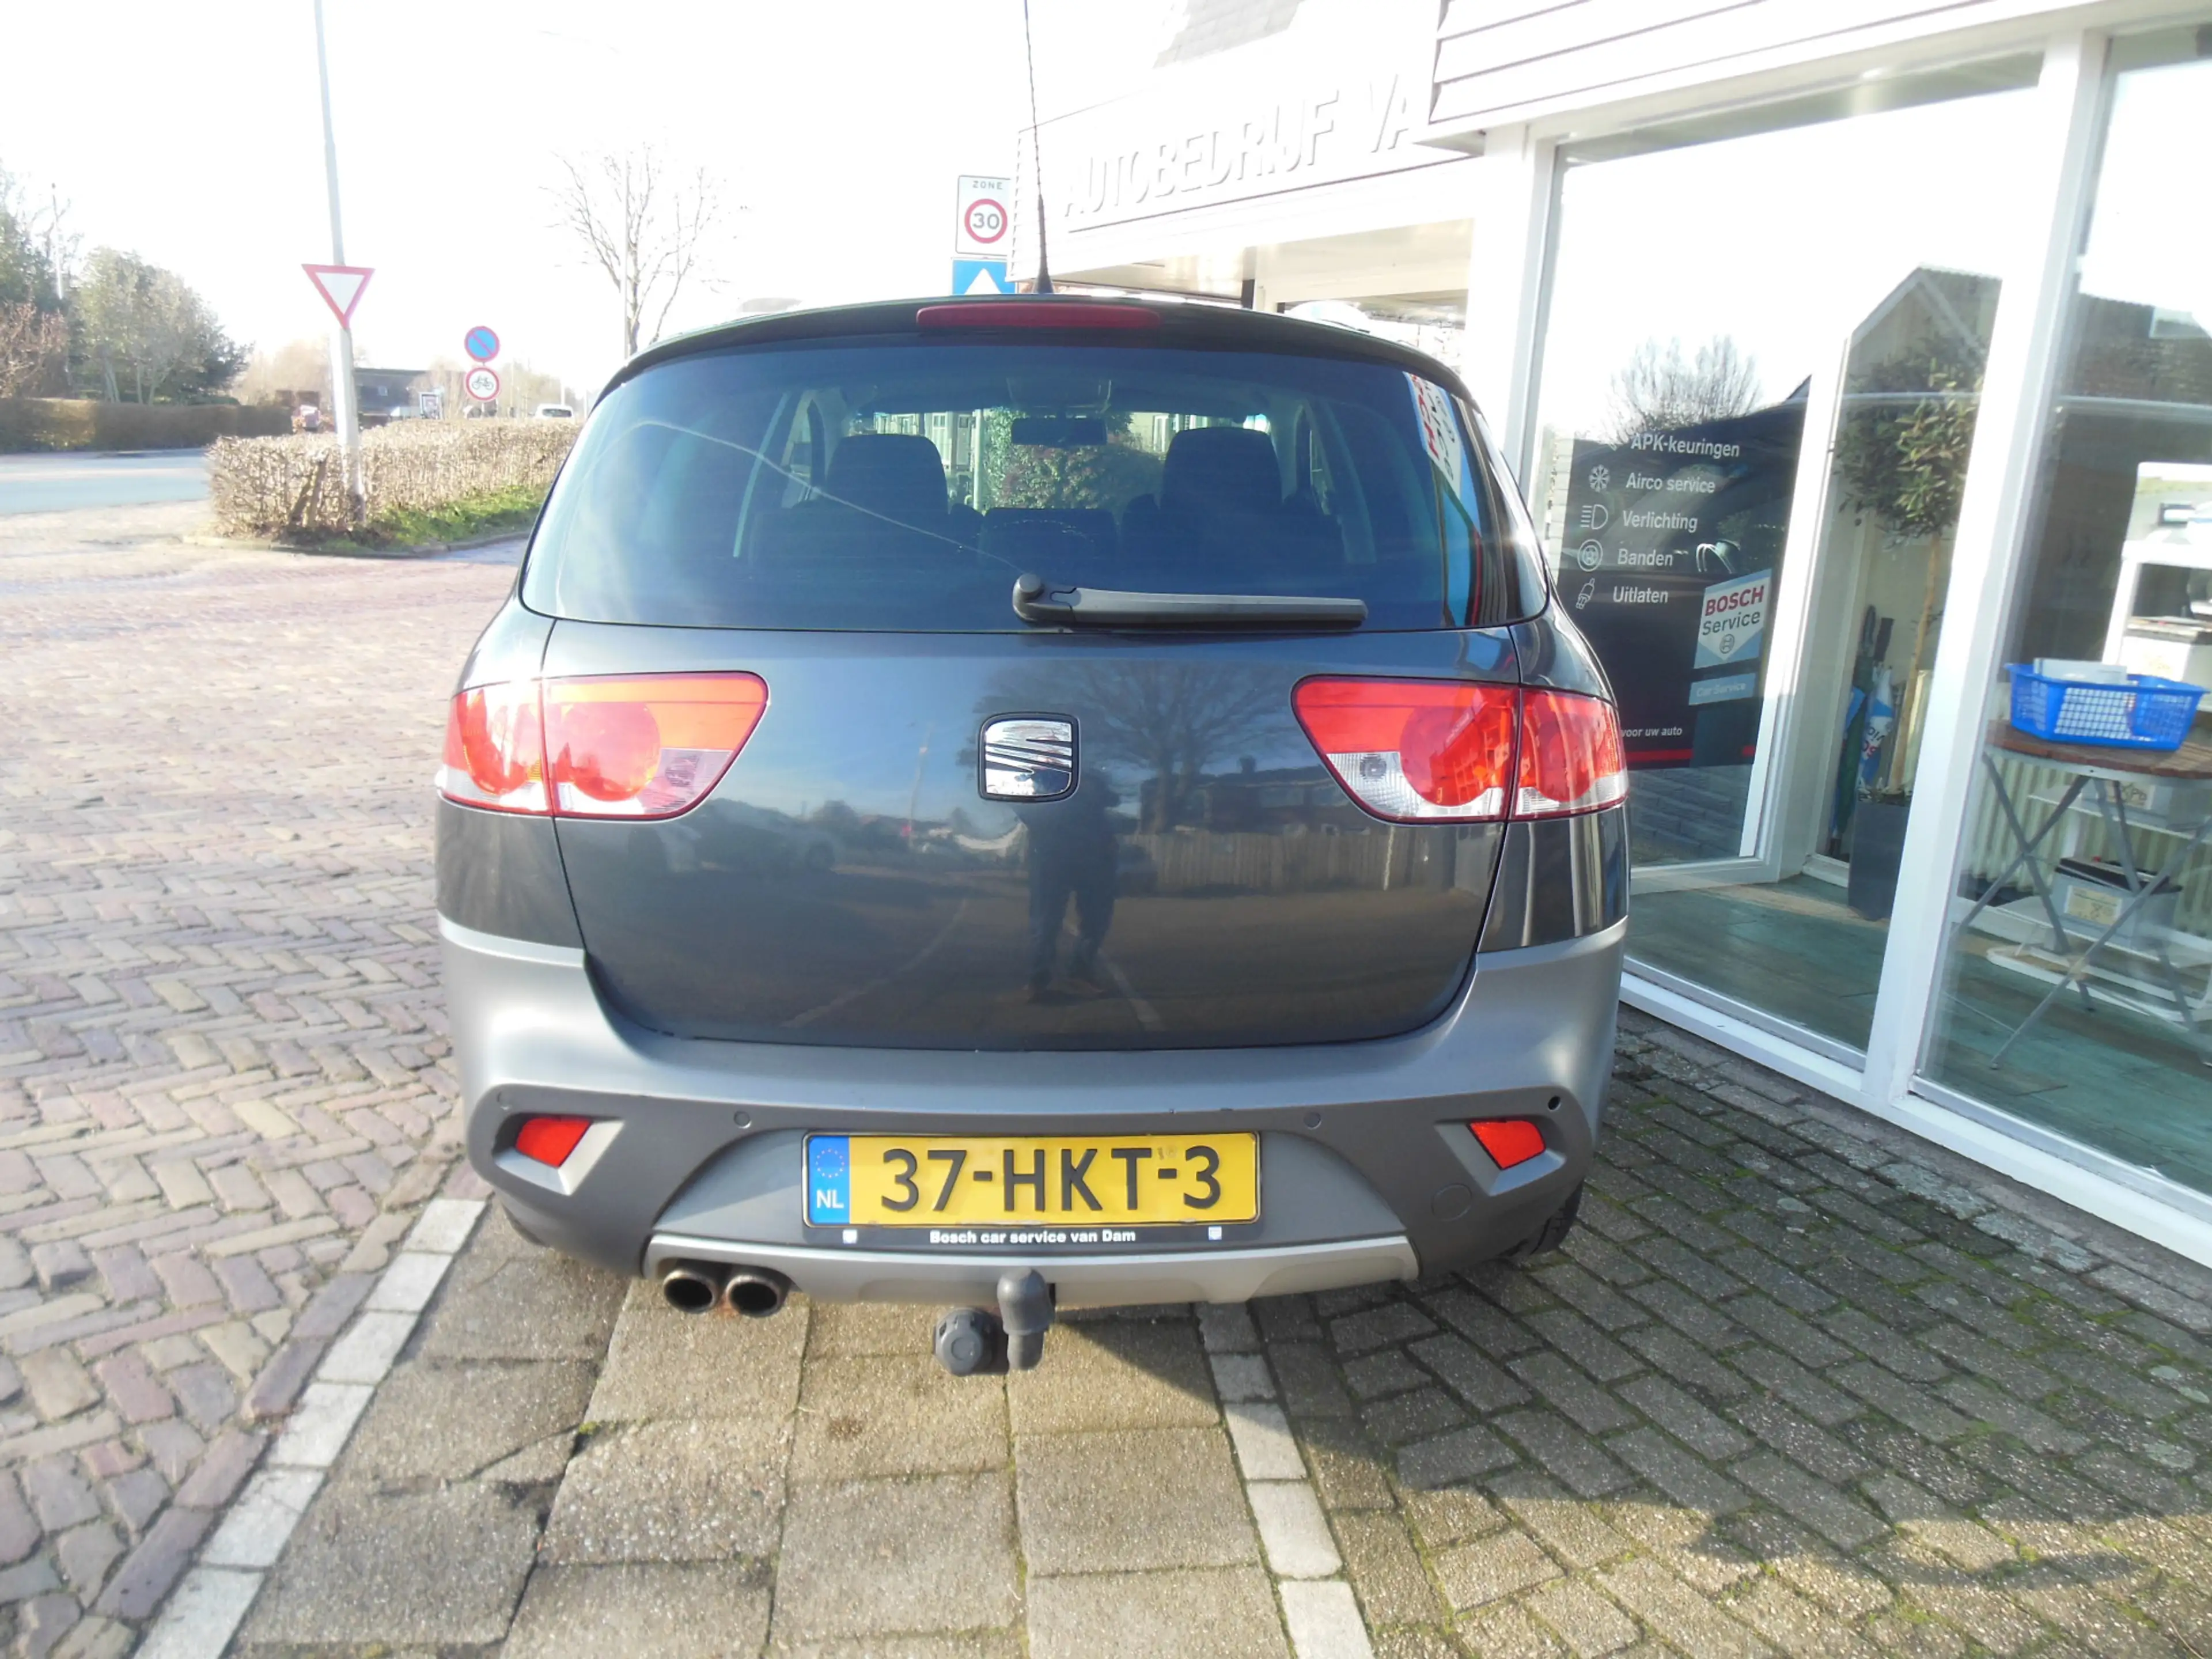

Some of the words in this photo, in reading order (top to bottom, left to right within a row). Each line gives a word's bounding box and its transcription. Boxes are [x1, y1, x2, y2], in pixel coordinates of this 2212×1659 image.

[1062, 89, 1340, 218] AUTOBEDRIJF
[972, 180, 1003, 190] ZONE
[972, 213, 1000, 230] 30
[1630, 433, 1740, 459] APK-keuringen
[1626, 472, 1663, 490] Airco
[1666, 477, 1715, 494] service
[1622, 510, 1698, 533] Verlichting
[1617, 548, 1673, 567] Banden
[1613, 585, 1669, 604] Uitlaten
[1705, 585, 1765, 616] BOSCH
[1702, 611, 1761, 636] Service
[1621, 728, 1642, 737] voor
[1645, 728, 1659, 737] uw
[1661, 725, 1683, 737] auto
[881, 1145, 1222, 1213] 37-HKT-3
[816, 1189, 844, 1209] NL
[930, 1230, 976, 1244] Bosch
[980, 1233, 1006, 1244] car
[1010, 1231, 1067, 1244] service
[1071, 1232, 1097, 1243] van
[1102, 1229, 1136, 1242] Dam
